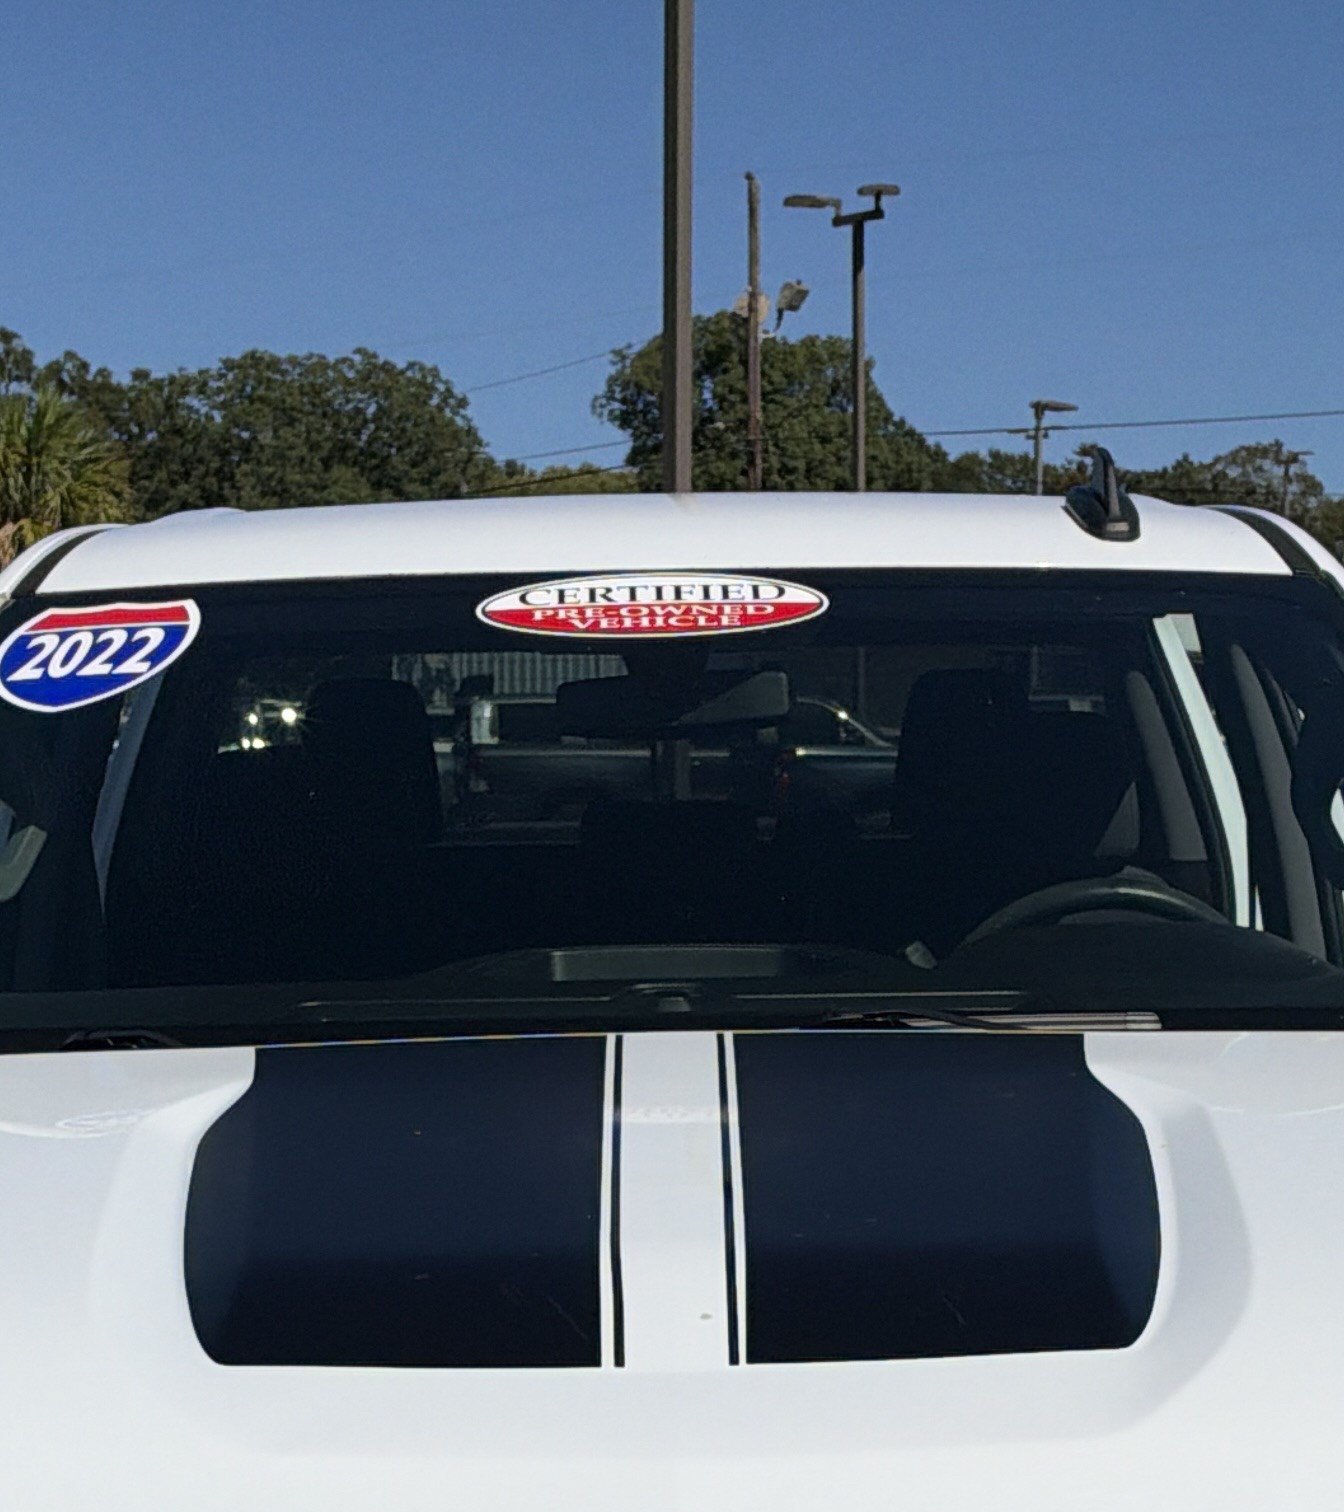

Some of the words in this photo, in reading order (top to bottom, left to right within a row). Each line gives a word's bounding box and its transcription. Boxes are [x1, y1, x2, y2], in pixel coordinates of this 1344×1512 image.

[518, 584, 787, 606] CERTIFIED
[532, 603, 775, 621] PRE-OWNED
[569, 615, 742, 630] VEHICLE
[6, 627, 165, 682] 2022
